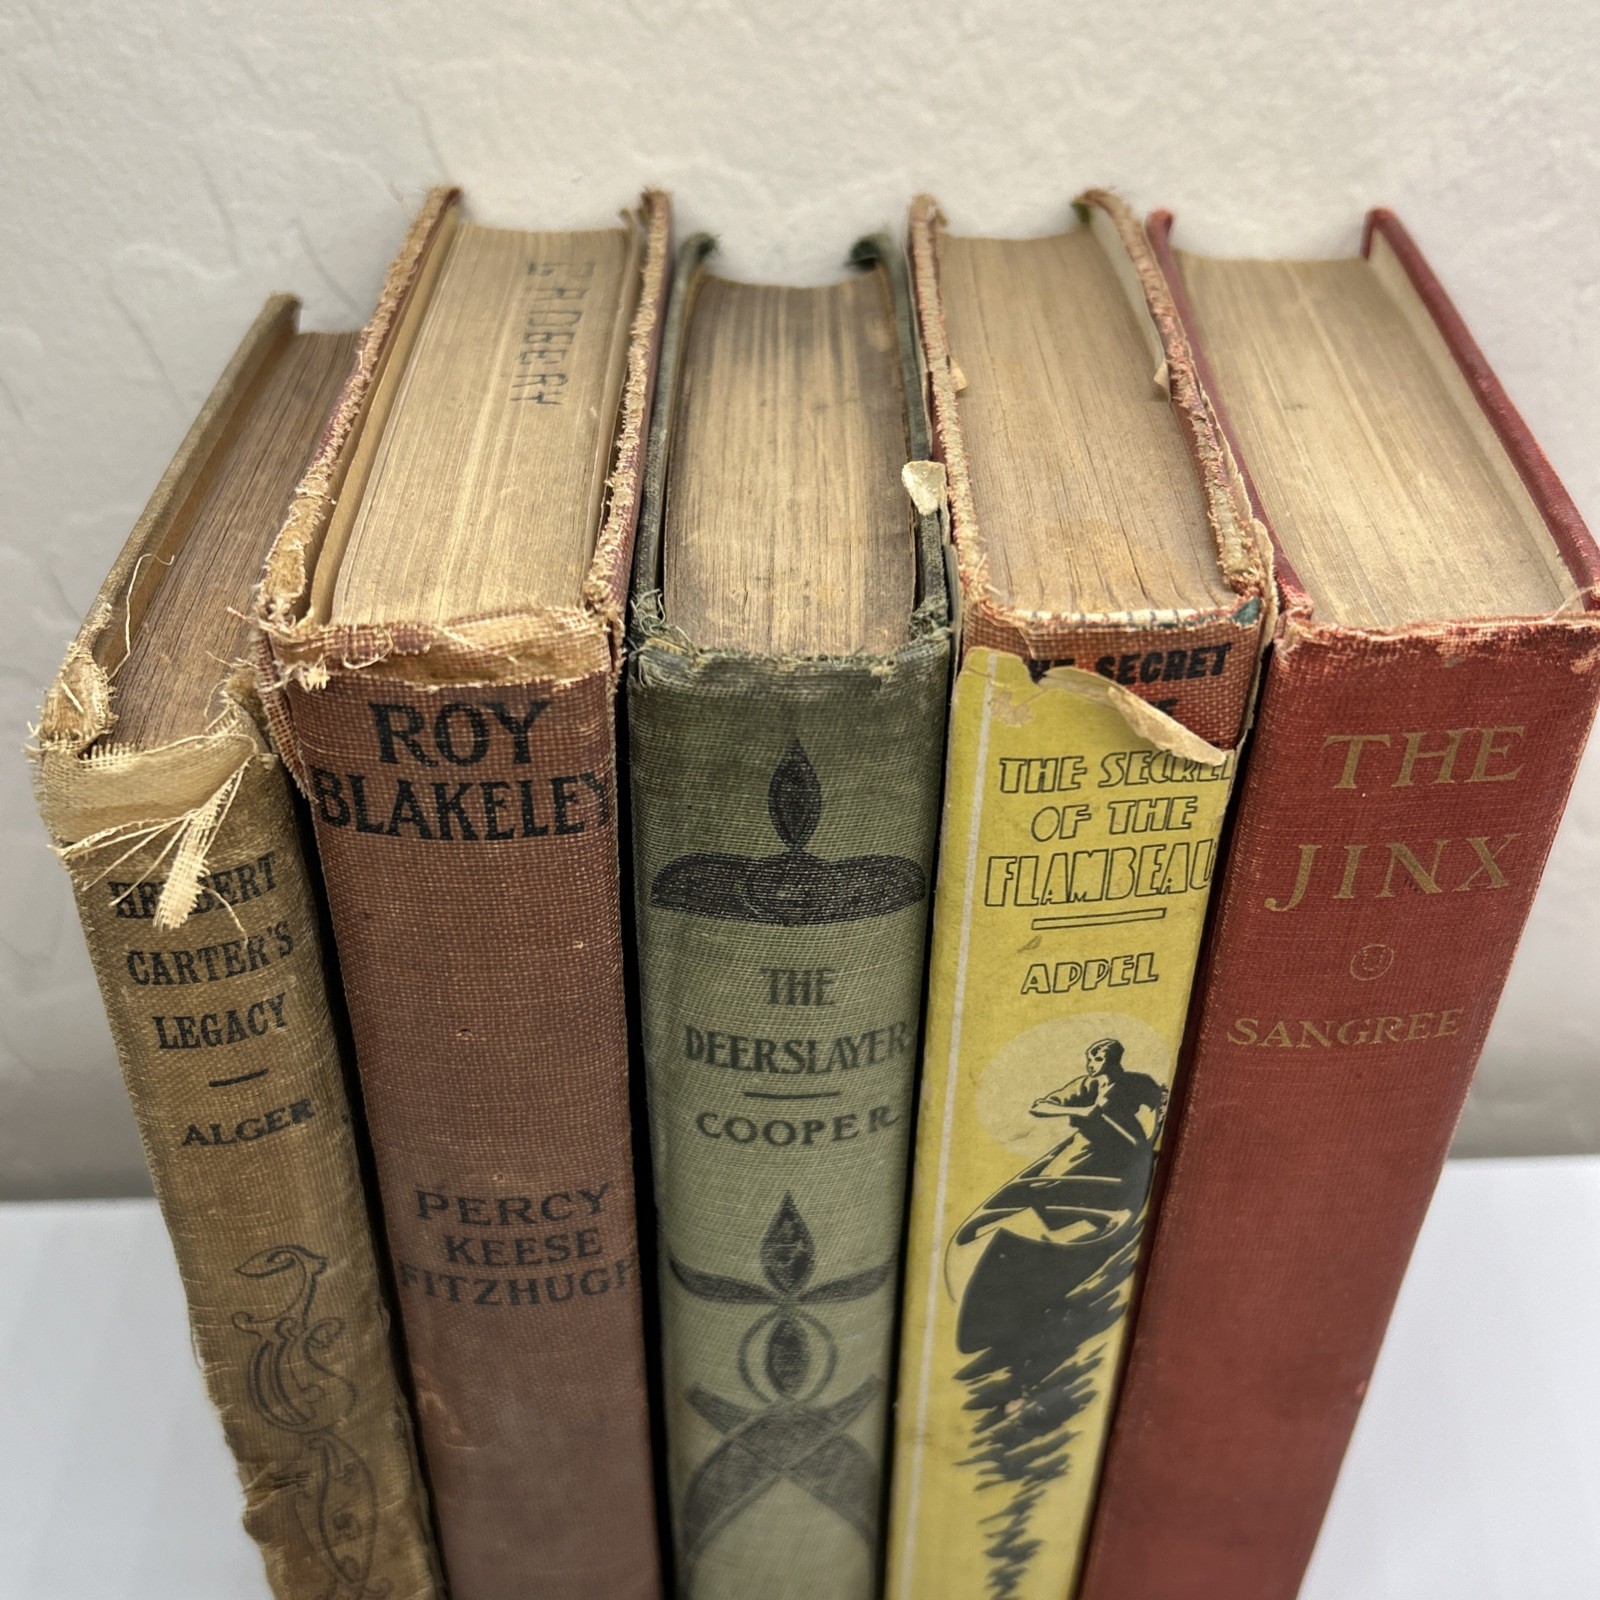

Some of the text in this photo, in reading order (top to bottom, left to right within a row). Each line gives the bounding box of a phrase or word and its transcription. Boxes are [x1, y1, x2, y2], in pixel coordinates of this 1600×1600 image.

[1095, 641, 1232, 686] SECRET
[369, 700, 550, 766] ROY
[999, 755, 1088, 794] THE
[1321, 726, 1525, 789] THE
[309, 765, 608, 840] BLAKELEY
[1031, 796, 1199, 842] OF THE
[984, 838, 1217, 907] FLAMBEAU
[1264, 833, 1521, 912] JINX
[127, 921, 294, 986] CARTER'S
[1020, 952, 1159, 995] APPEL
[760, 967, 836, 1006] THE
[152, 993, 287, 1050] LEGACY
[1226, 1008, 1465, 1048] SANGREE
[684, 1020, 913, 1075] DEERSLAYER
[182, 1099, 315, 1147] ALGER
[696, 1105, 901, 1147] COOPER
[415, 1181, 612, 1226] PERCY
[443, 1227, 603, 1266] KEESE
